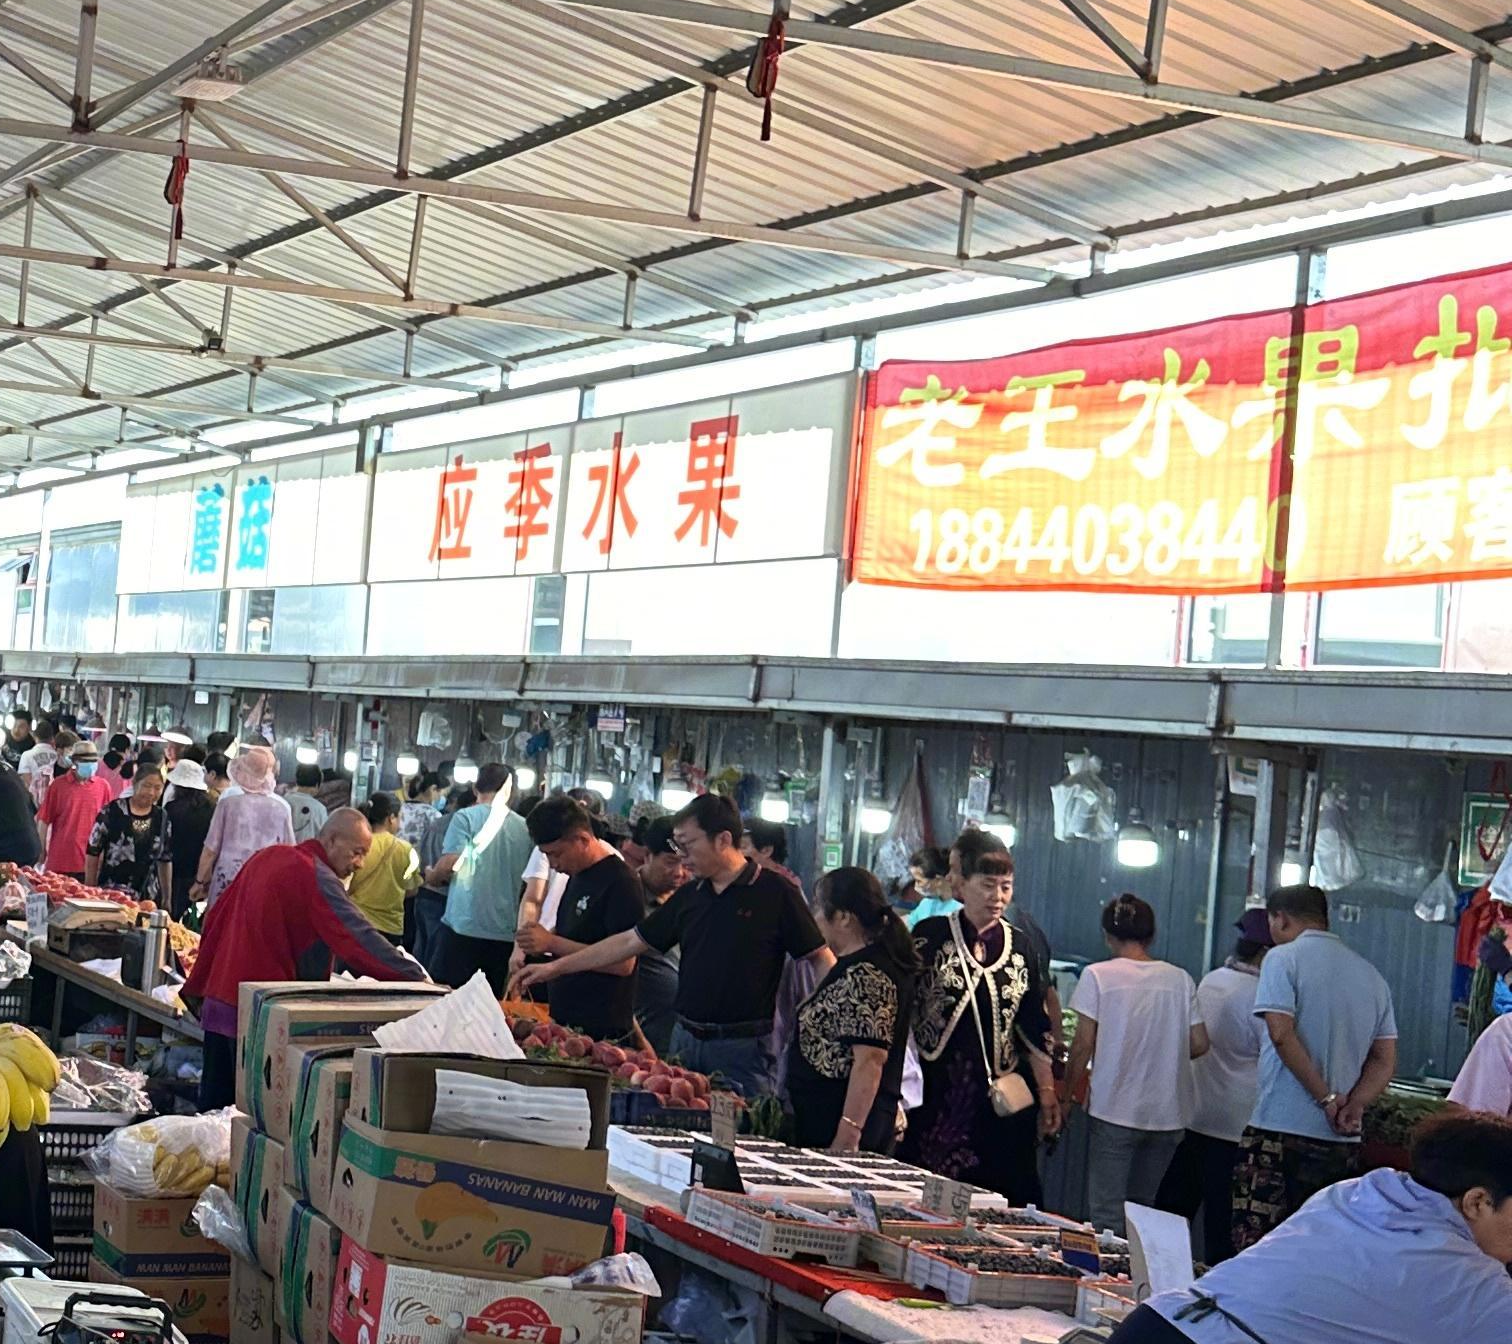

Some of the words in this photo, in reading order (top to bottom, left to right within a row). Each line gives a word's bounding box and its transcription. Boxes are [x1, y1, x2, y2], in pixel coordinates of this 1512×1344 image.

[428, 414, 741, 564] 应季水果
[468, 1172, 532, 1197] BANANAS
[534, 1185, 566, 1204] MAN
[568, 1190, 600, 1210] MAN
[136, 1263, 160, 1273] MAN
[188, 1262, 230, 1273] BANANA
